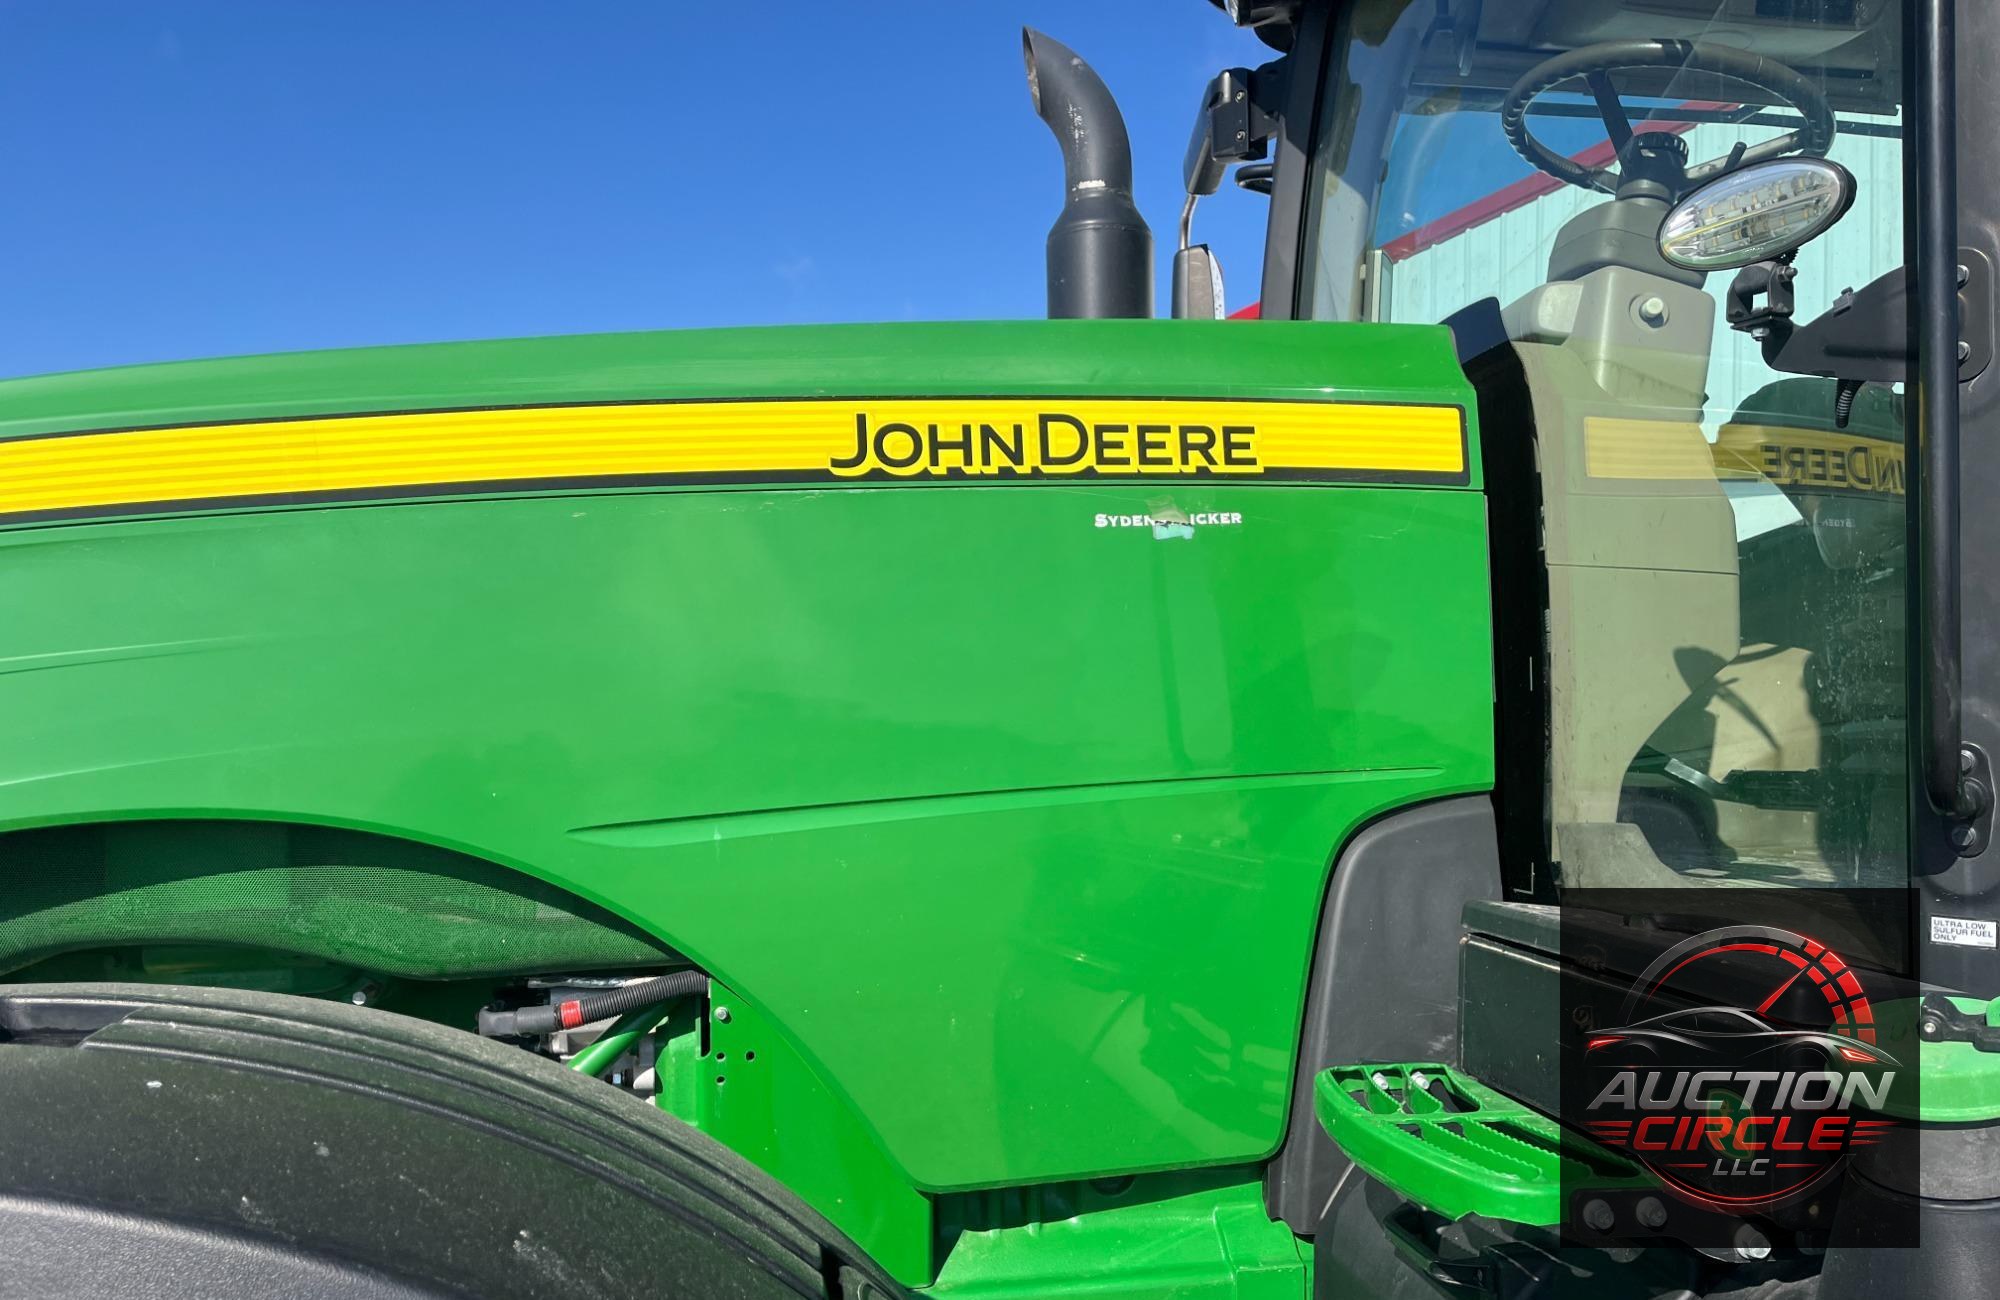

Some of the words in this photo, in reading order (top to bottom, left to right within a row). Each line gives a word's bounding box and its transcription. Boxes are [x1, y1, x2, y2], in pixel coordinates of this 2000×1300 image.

[829, 412, 1025, 471] JOHN
[1037, 412, 1259, 470] DEERE
[1094, 512, 1243, 528] SYDENICKER
[1933, 919, 1963, 928] ULTRA
[1965, 922, 1987, 930] LOW
[1933, 926, 1969, 936] SULFUR
[1970, 929, 1994, 938] FUEL
[1933, 933, 1957, 941] ONLY
